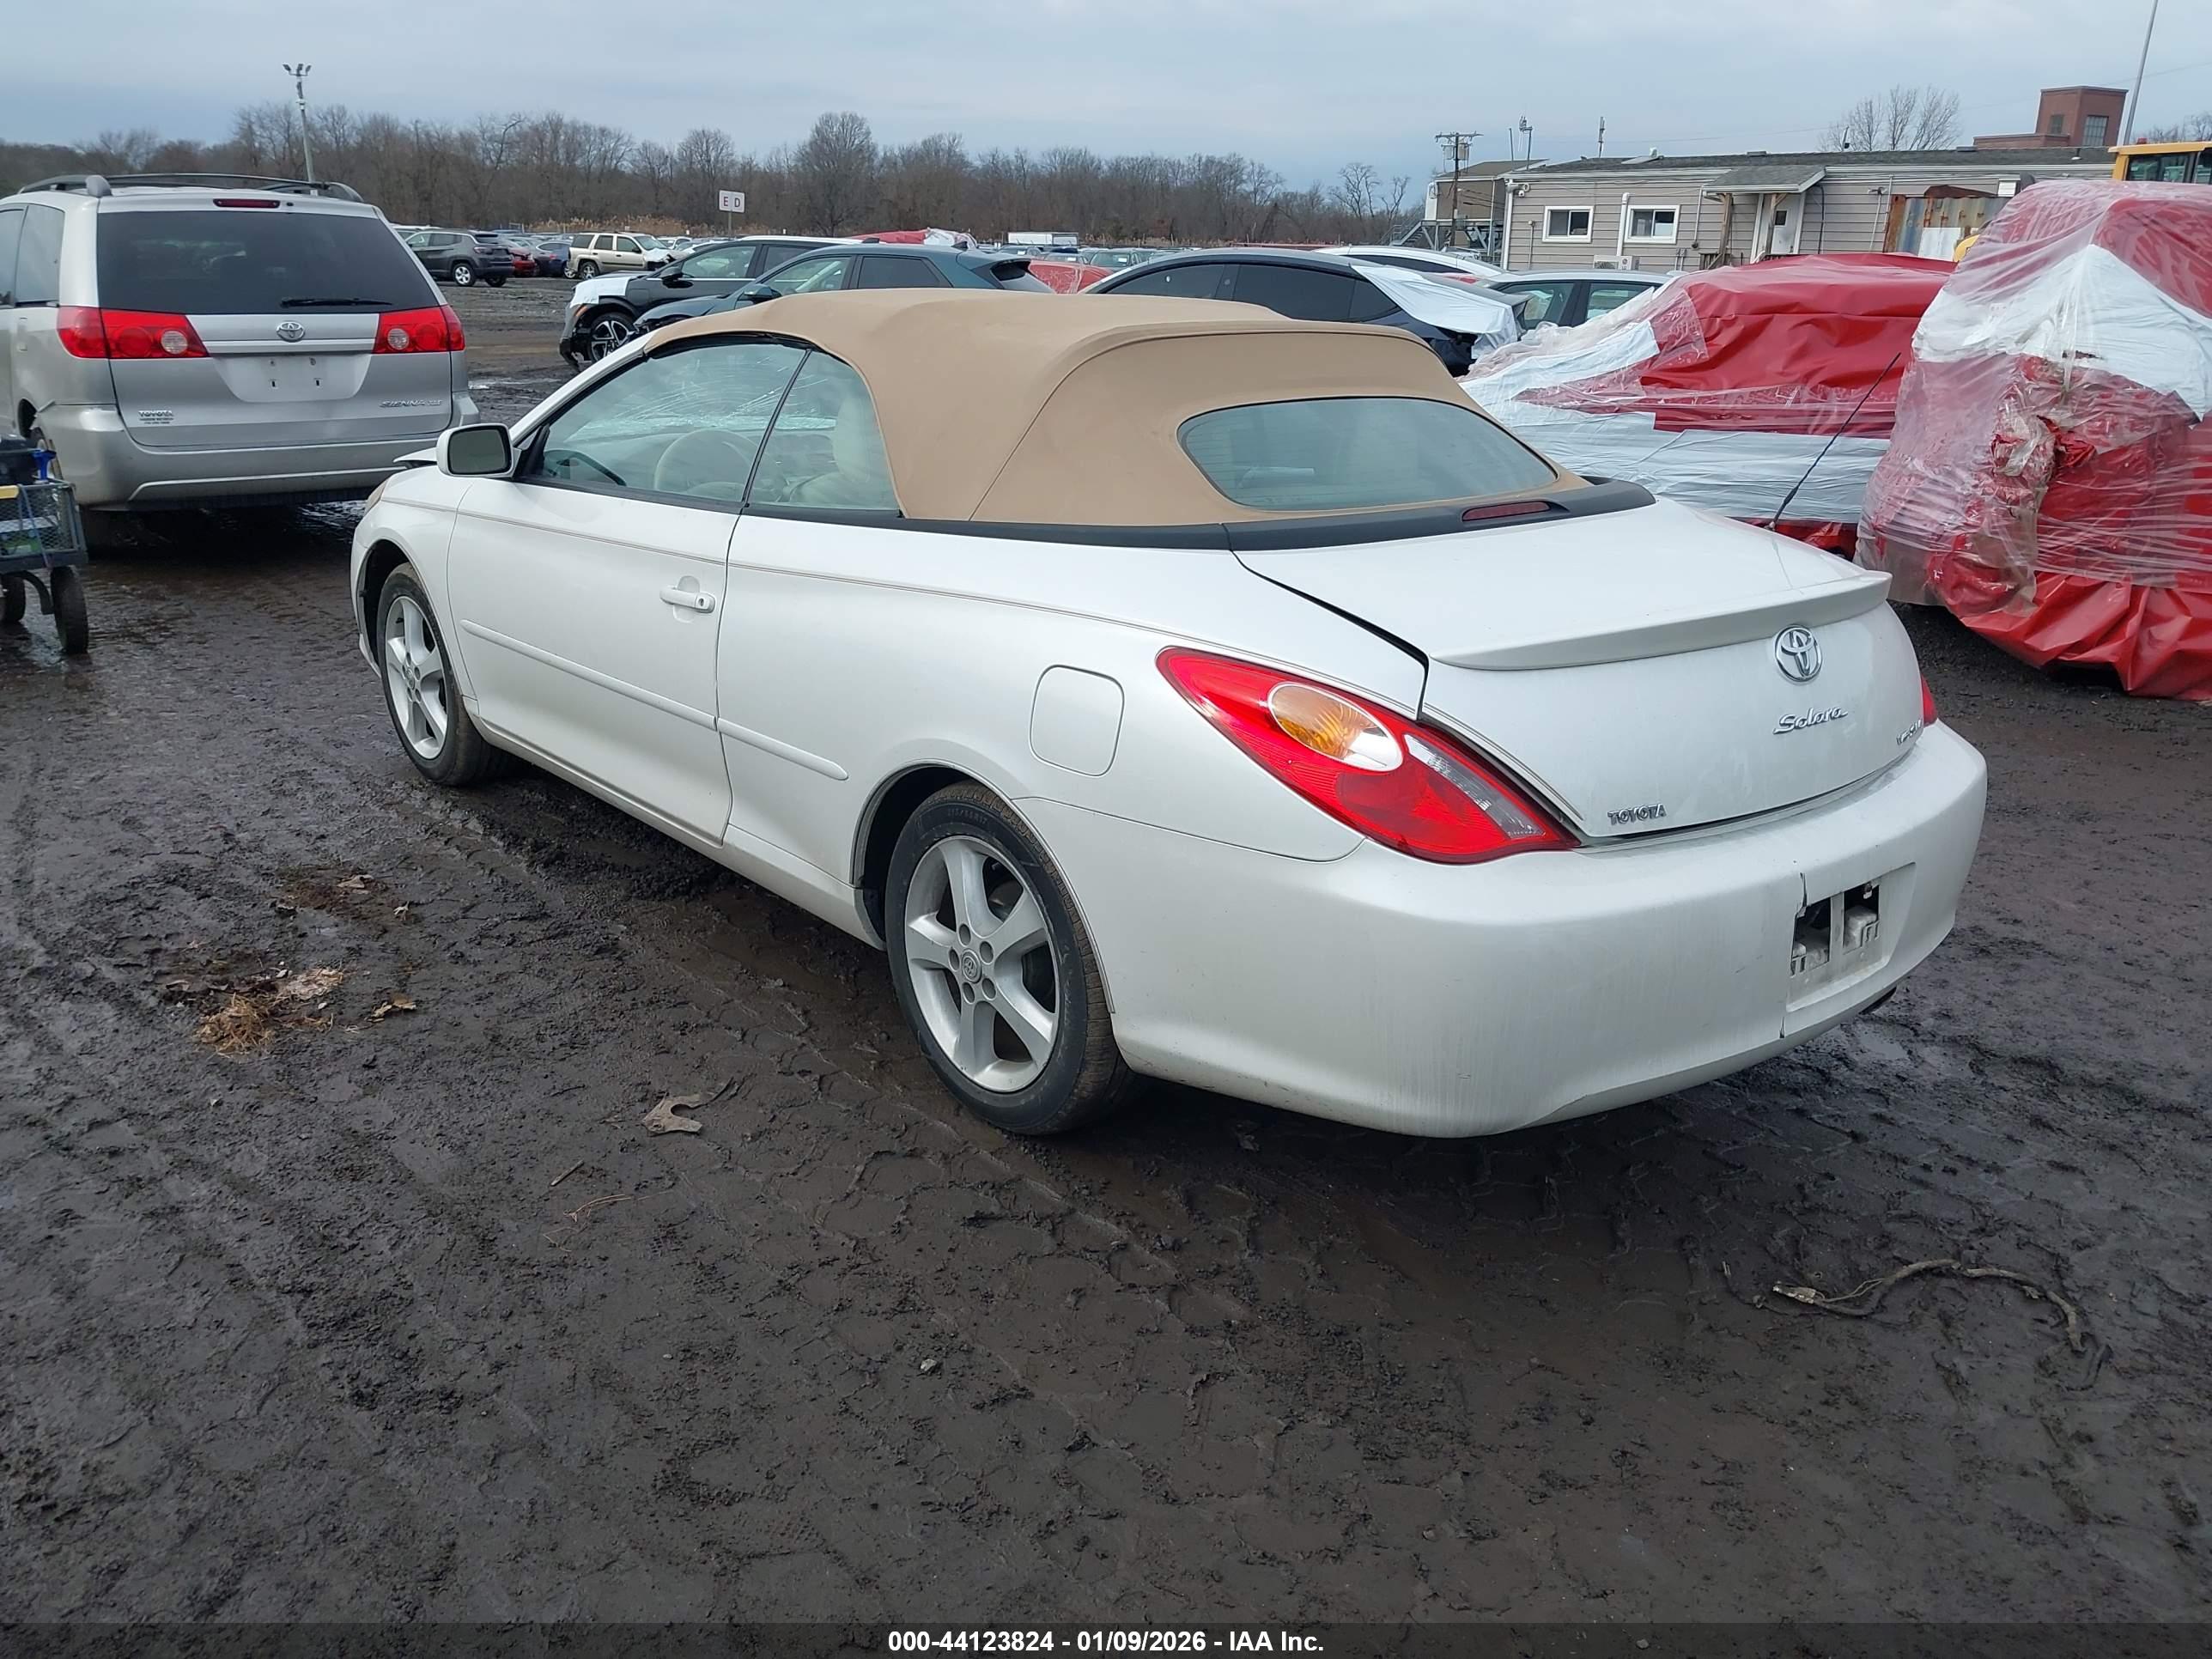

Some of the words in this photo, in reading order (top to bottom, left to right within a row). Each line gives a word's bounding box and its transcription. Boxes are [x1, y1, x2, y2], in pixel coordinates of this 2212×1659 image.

[723, 196, 729, 207] E
[734, 198, 741, 208] D
[1772, 707, 1849, 735] Solara
[1607, 803, 1667, 825] TOYOTA
